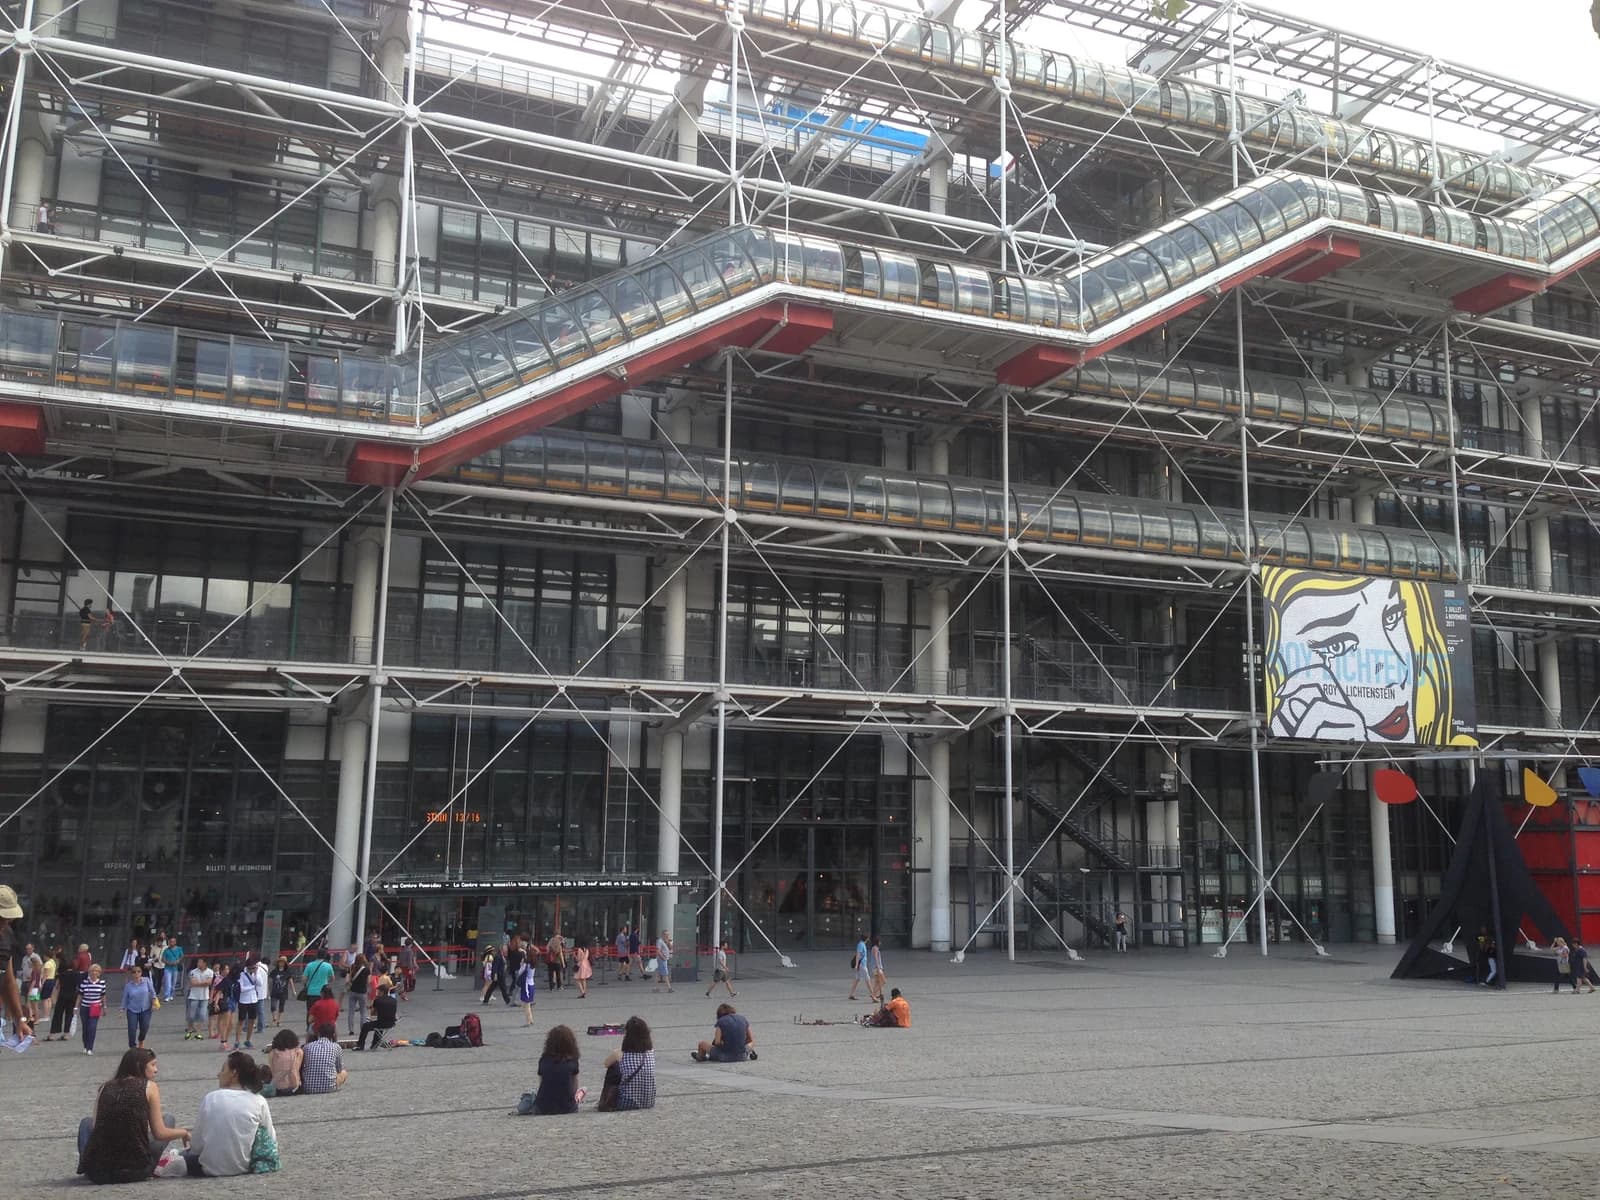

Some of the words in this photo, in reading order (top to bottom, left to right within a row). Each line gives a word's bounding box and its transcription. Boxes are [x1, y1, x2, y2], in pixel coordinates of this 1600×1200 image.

[1323, 683, 1338, 696] ROY
[1346, 684, 1396, 700] LICHTENSTEIN
[426, 811, 451, 823] STUDI
